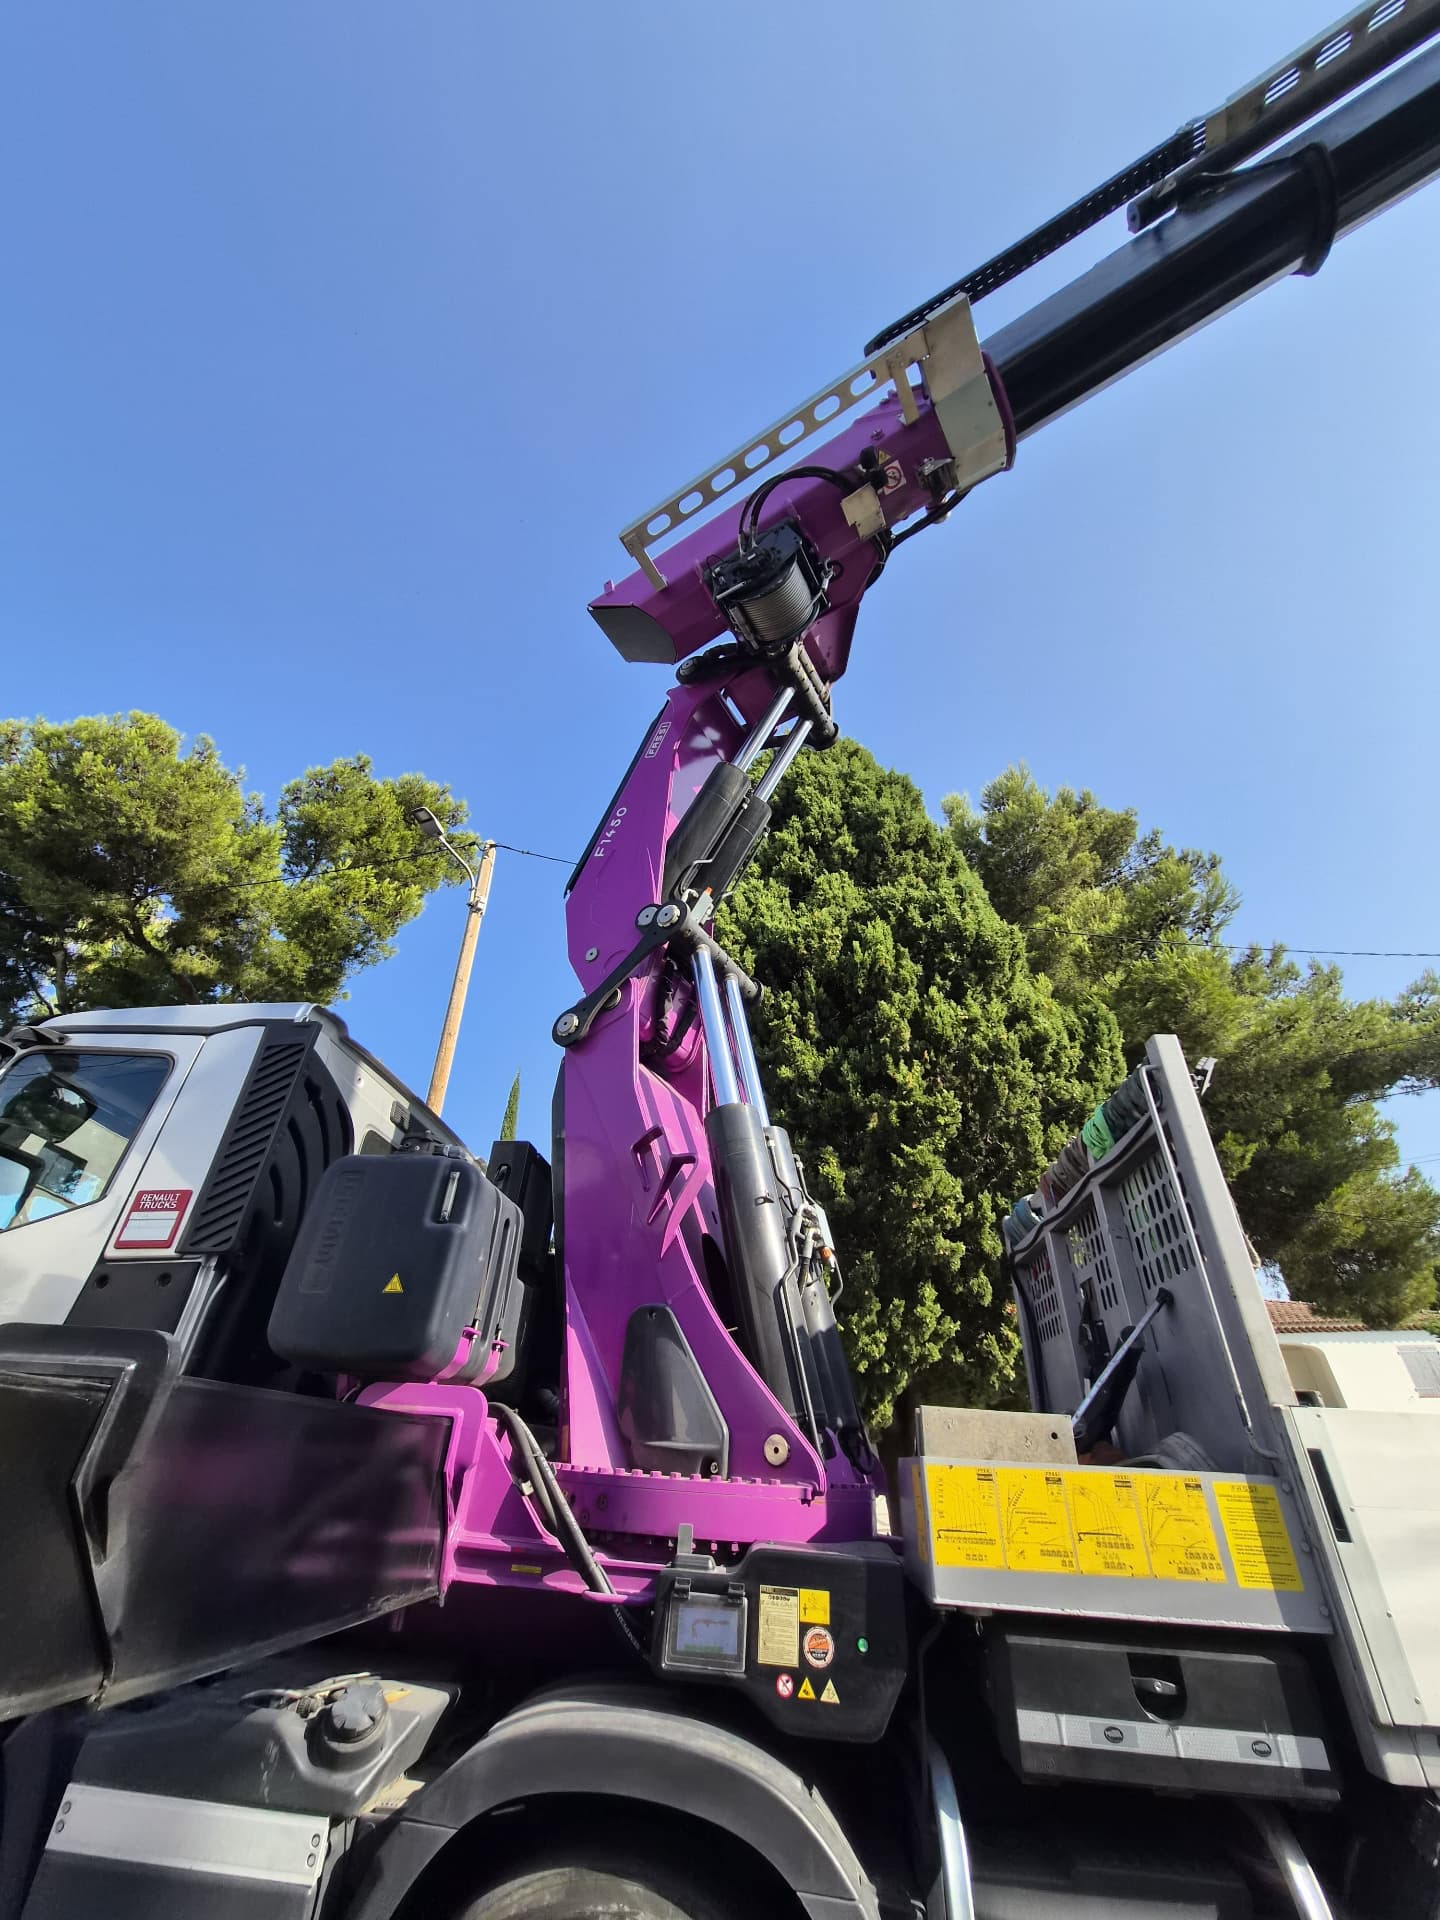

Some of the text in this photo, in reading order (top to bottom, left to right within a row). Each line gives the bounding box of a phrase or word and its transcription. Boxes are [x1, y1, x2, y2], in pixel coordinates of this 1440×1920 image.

[648, 724, 669, 756] FASSI
[594, 807, 627, 857] F1450
[139, 1201, 177, 1209] TRUCKS
[141, 1193, 181, 1202] RENAULT
